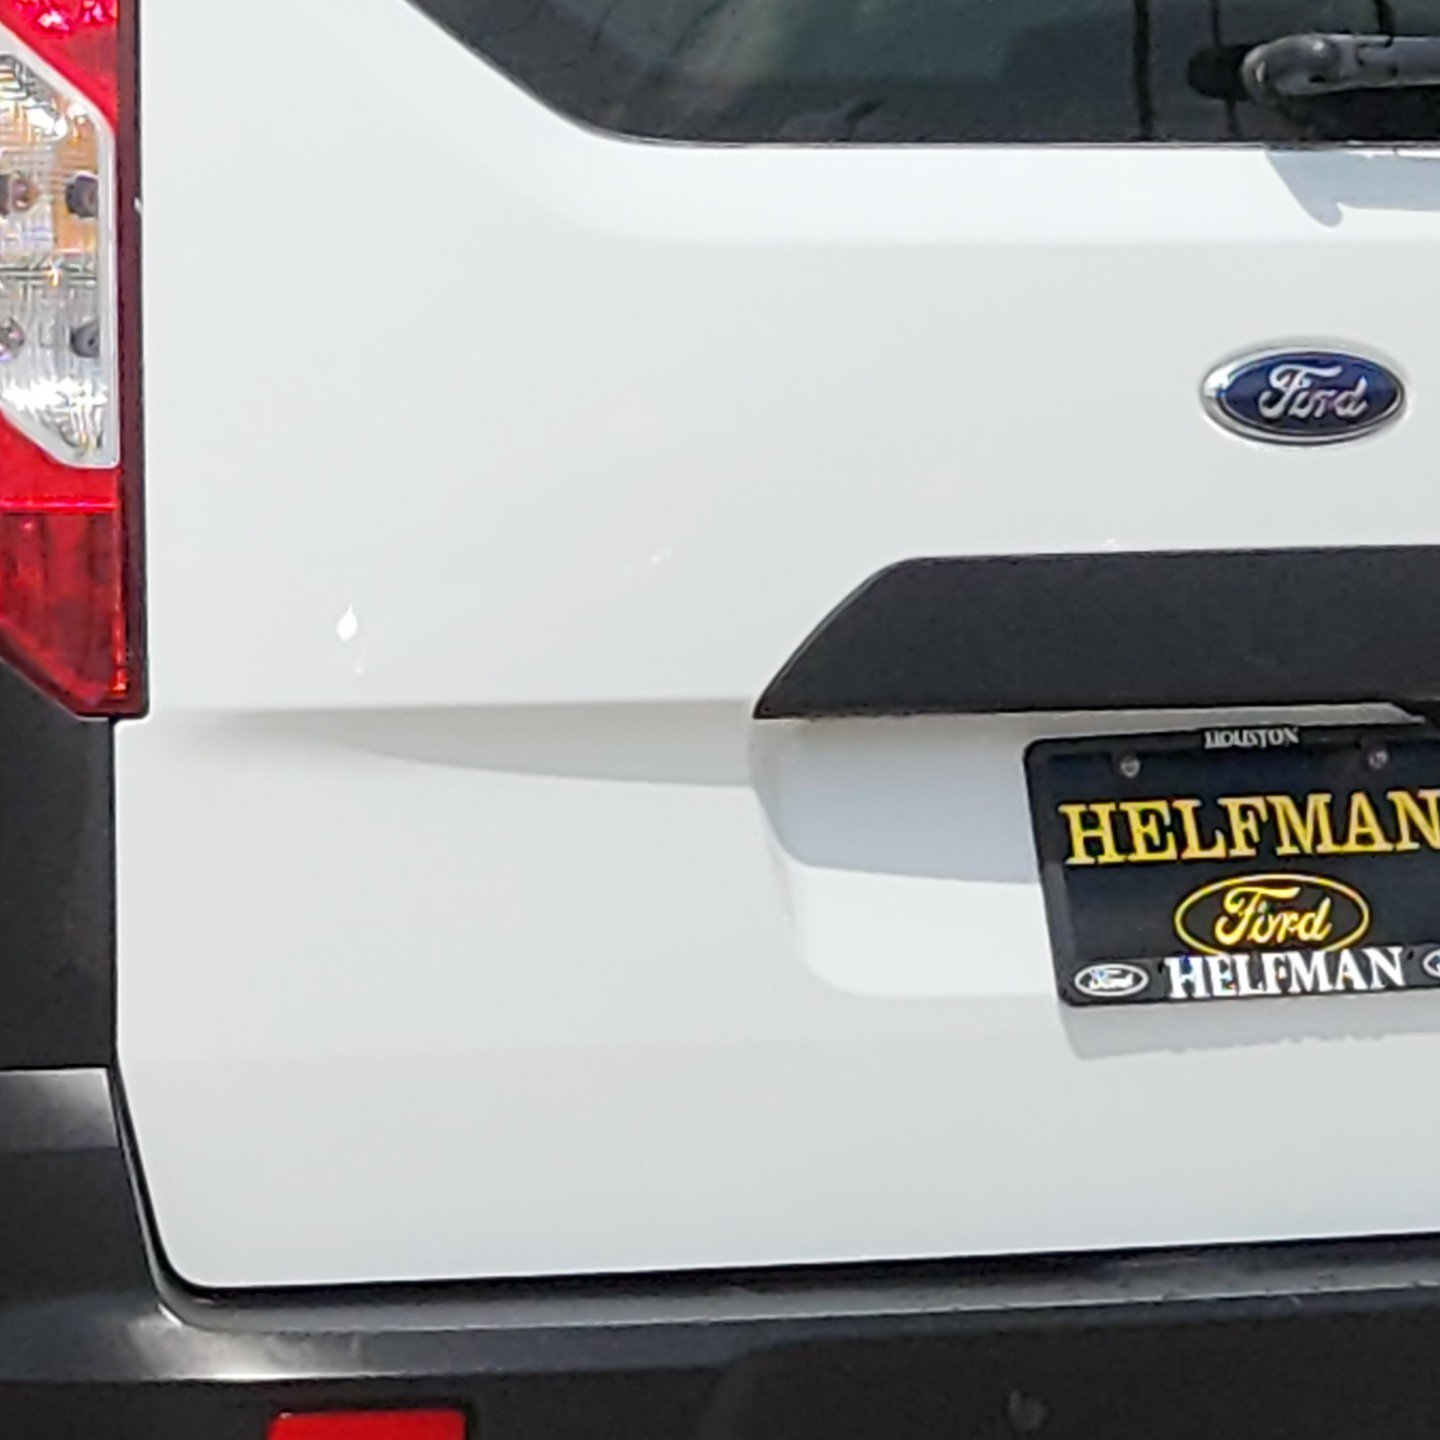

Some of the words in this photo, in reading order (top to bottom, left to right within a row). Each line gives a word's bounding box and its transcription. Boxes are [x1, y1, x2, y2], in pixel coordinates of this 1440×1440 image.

[1258, 363, 1369, 419] Ford
[1203, 726, 1300, 751] HOUSTON
[1213, 885, 1333, 947] Ford
[1163, 946, 1408, 1000] HELFMAN
